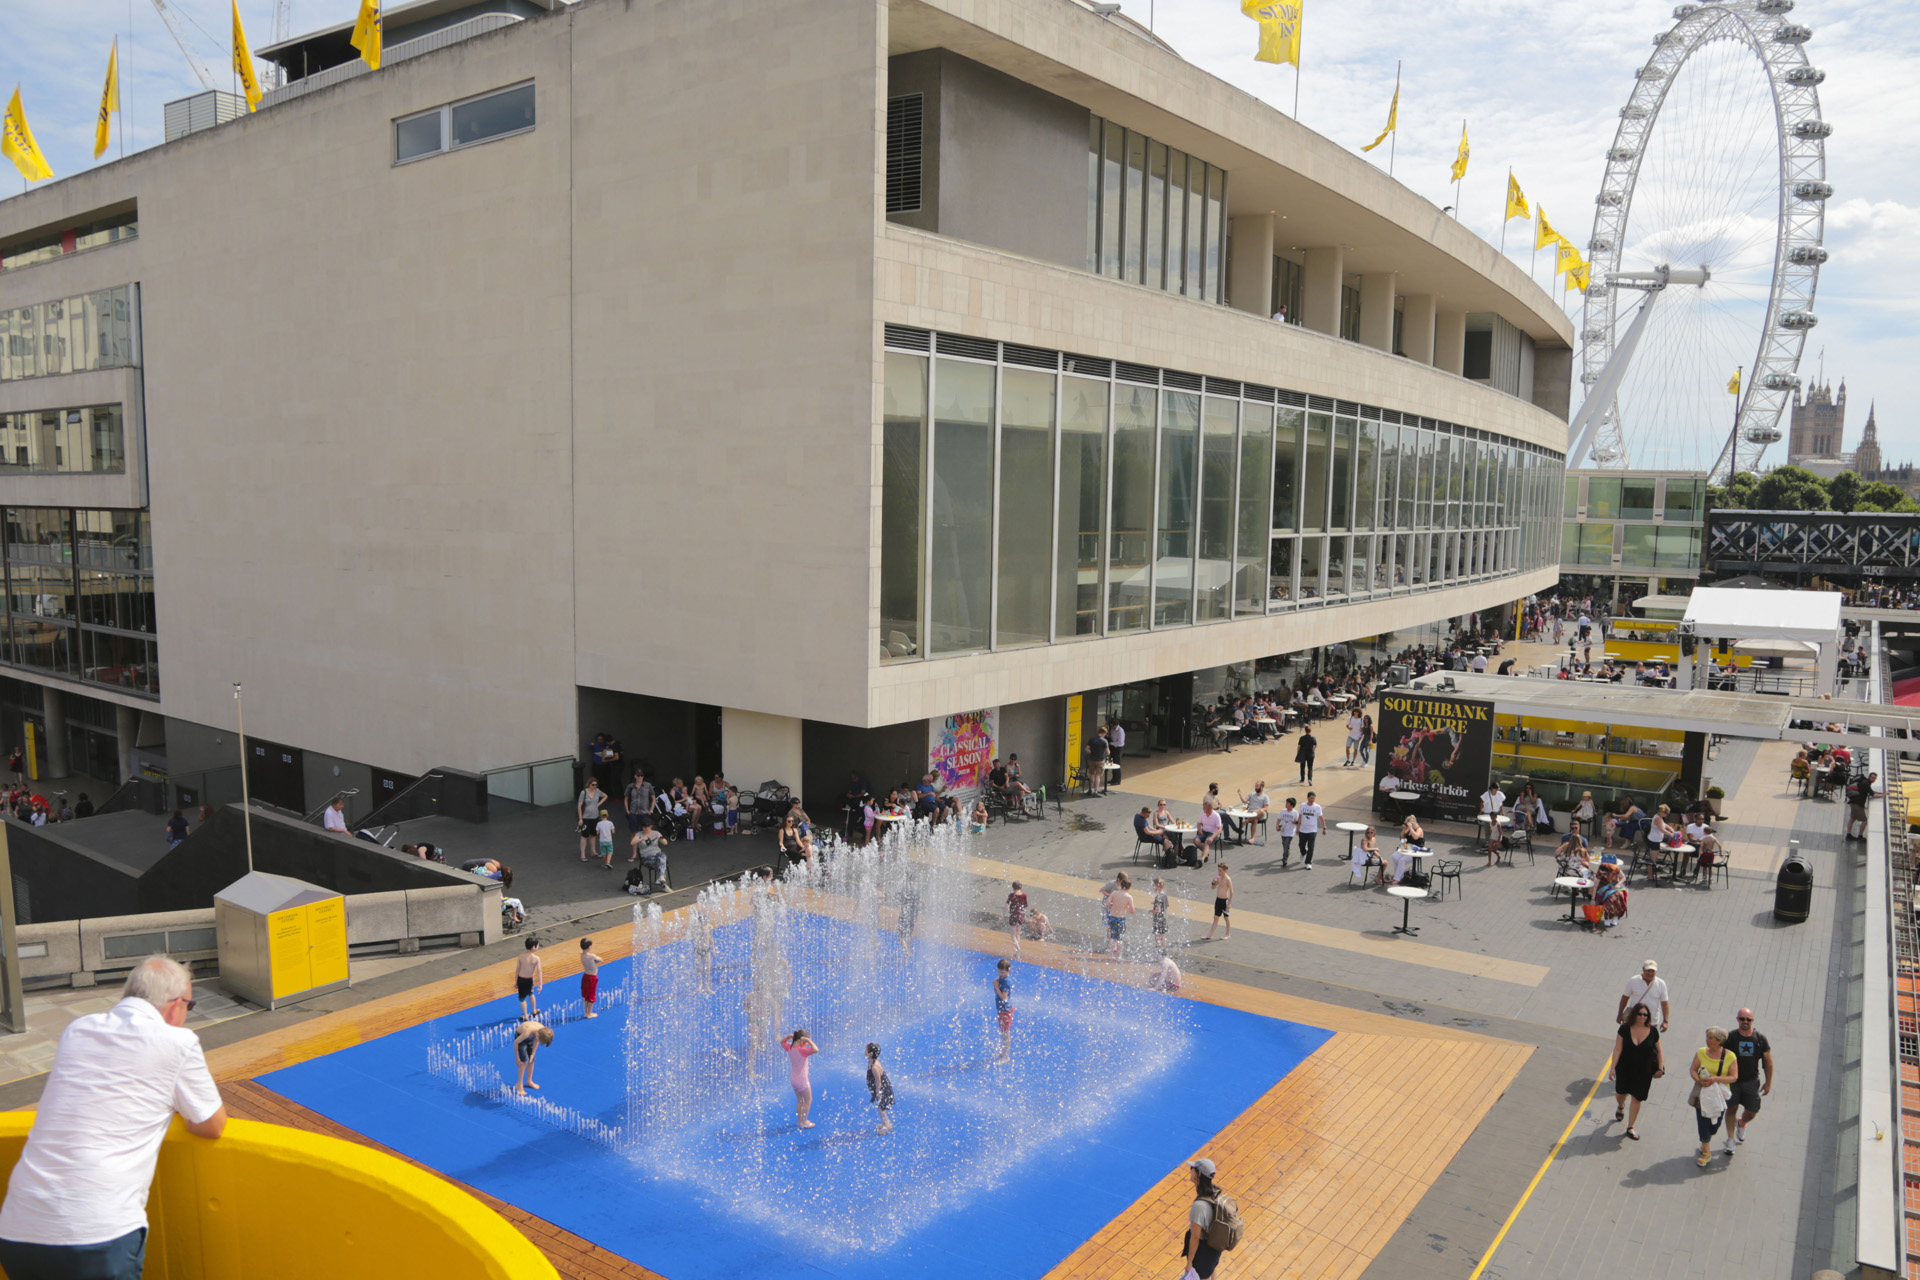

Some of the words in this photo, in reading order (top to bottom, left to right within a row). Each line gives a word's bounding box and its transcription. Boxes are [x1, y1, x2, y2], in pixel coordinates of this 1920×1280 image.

[1384, 697, 1488, 720] SOUTHBANK
[945, 710, 985, 729] CENTRE
[1402, 714, 1468, 734] CENTRE
[940, 736, 988, 756] CLASSICAL
[946, 751, 982, 770] SEASON
[1399, 779, 1429, 792] irkus
